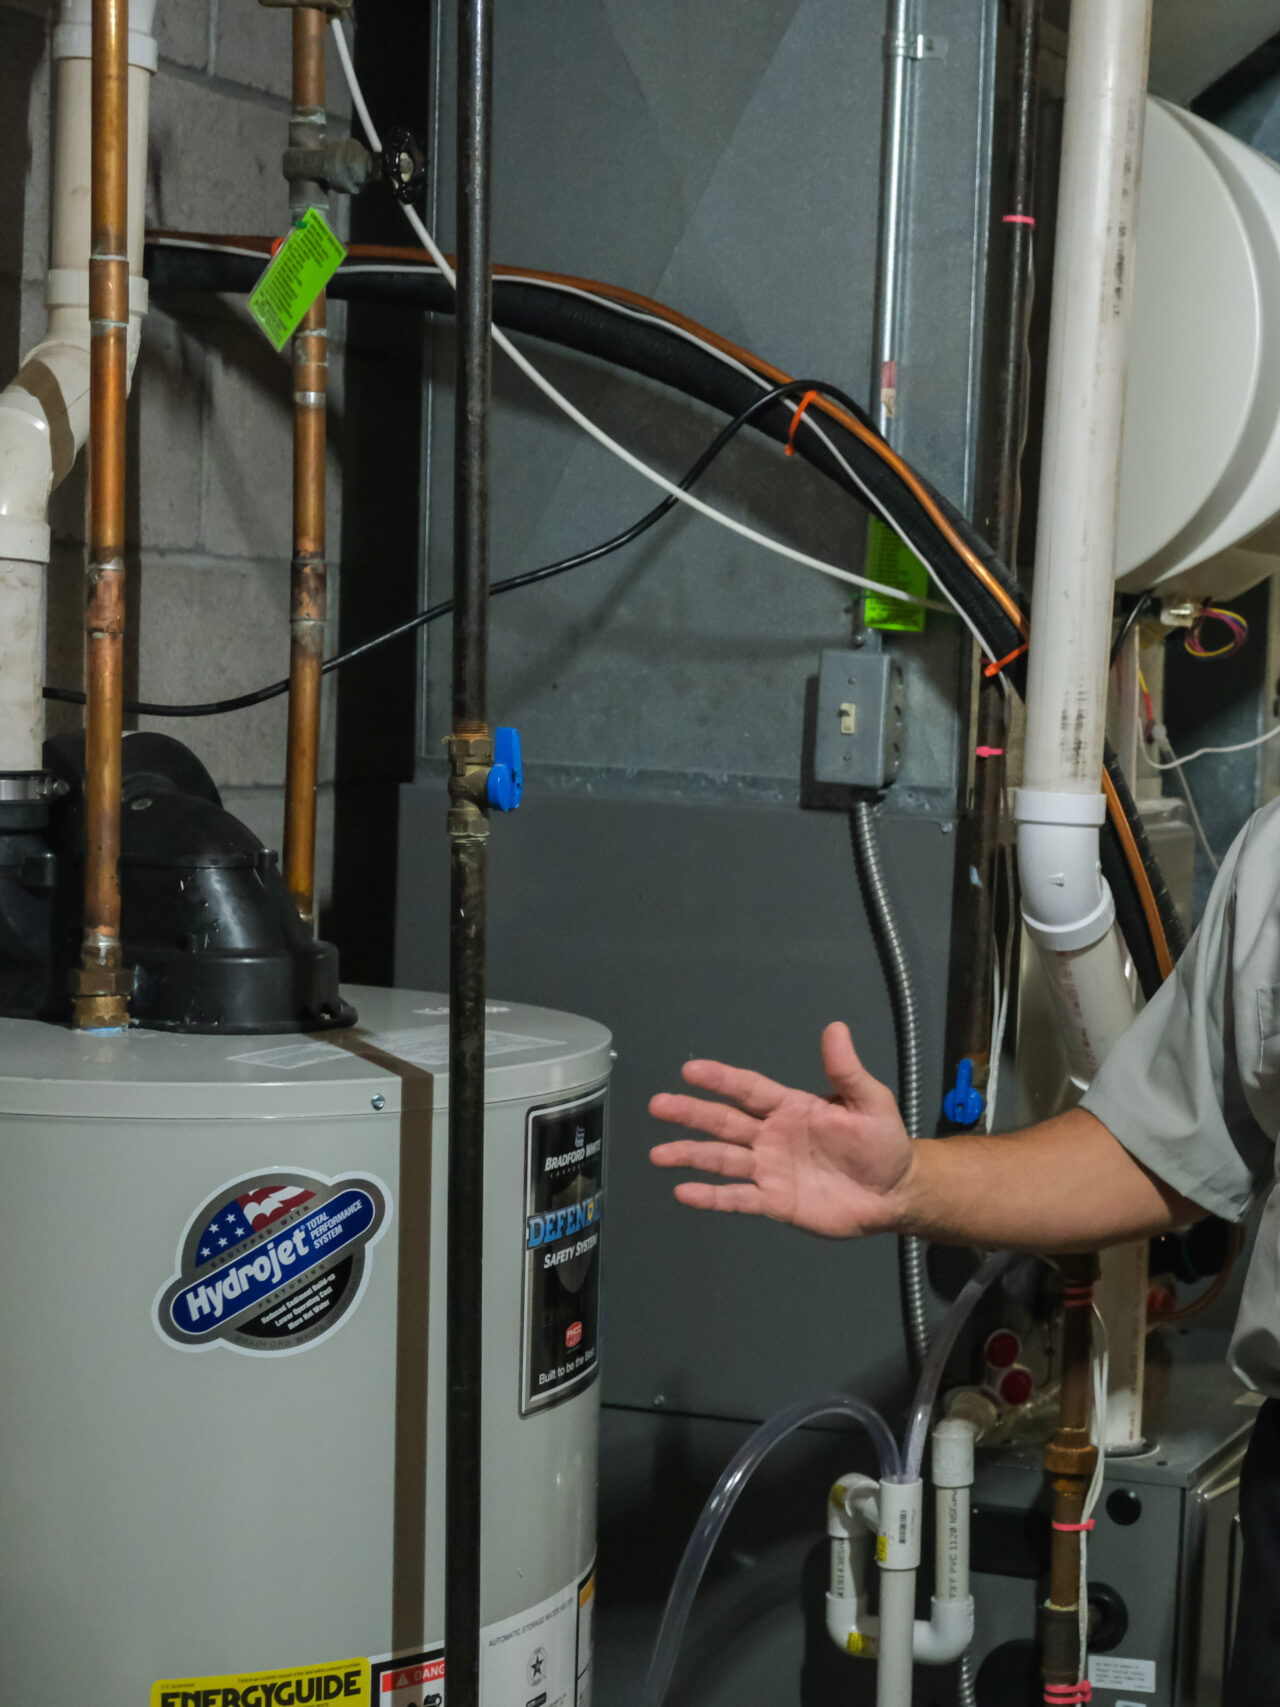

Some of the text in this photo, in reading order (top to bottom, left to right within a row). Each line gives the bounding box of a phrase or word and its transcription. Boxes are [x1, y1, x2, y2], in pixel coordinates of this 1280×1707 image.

[544, 1147, 586, 1172] BRADFORD
[304, 1211, 330, 1231] TOTAL
[309, 1199, 364, 1241] PERFORMANCE
[312, 1225, 344, 1250] SYSTEM
[543, 1245, 576, 1269] SAFETY
[258, 1264, 325, 1308] FEATURING
[538, 1368, 557, 1386] Built
[557, 1366, 566, 1378] to
[565, 1361, 575, 1373] be
[949, 1527, 958, 1551] 1120
[949, 1553, 958, 1575] PVC
[413, 1663, 445, 1682] DANG
